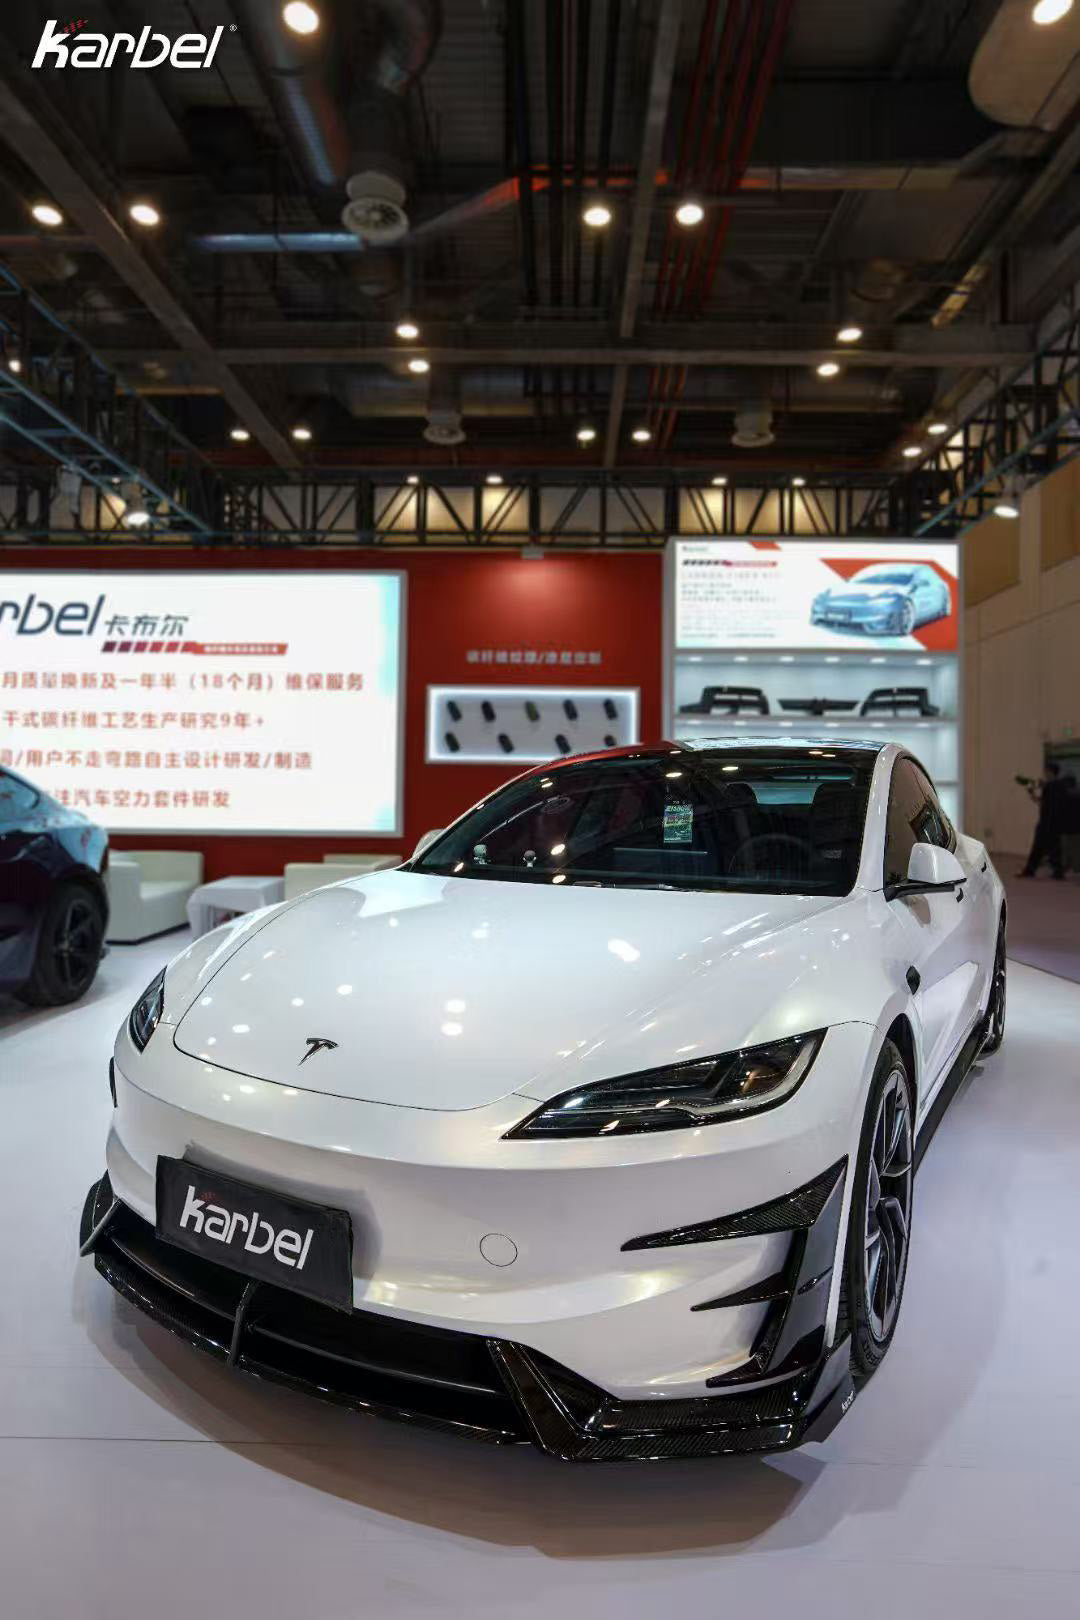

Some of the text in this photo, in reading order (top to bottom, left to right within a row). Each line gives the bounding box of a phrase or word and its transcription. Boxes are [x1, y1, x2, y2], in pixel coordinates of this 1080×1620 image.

[105, 614, 189, 636] 卡布尔
[45, 788, 230, 808] 注汽车空力套件研发
[179, 1185, 314, 1270] karbel
